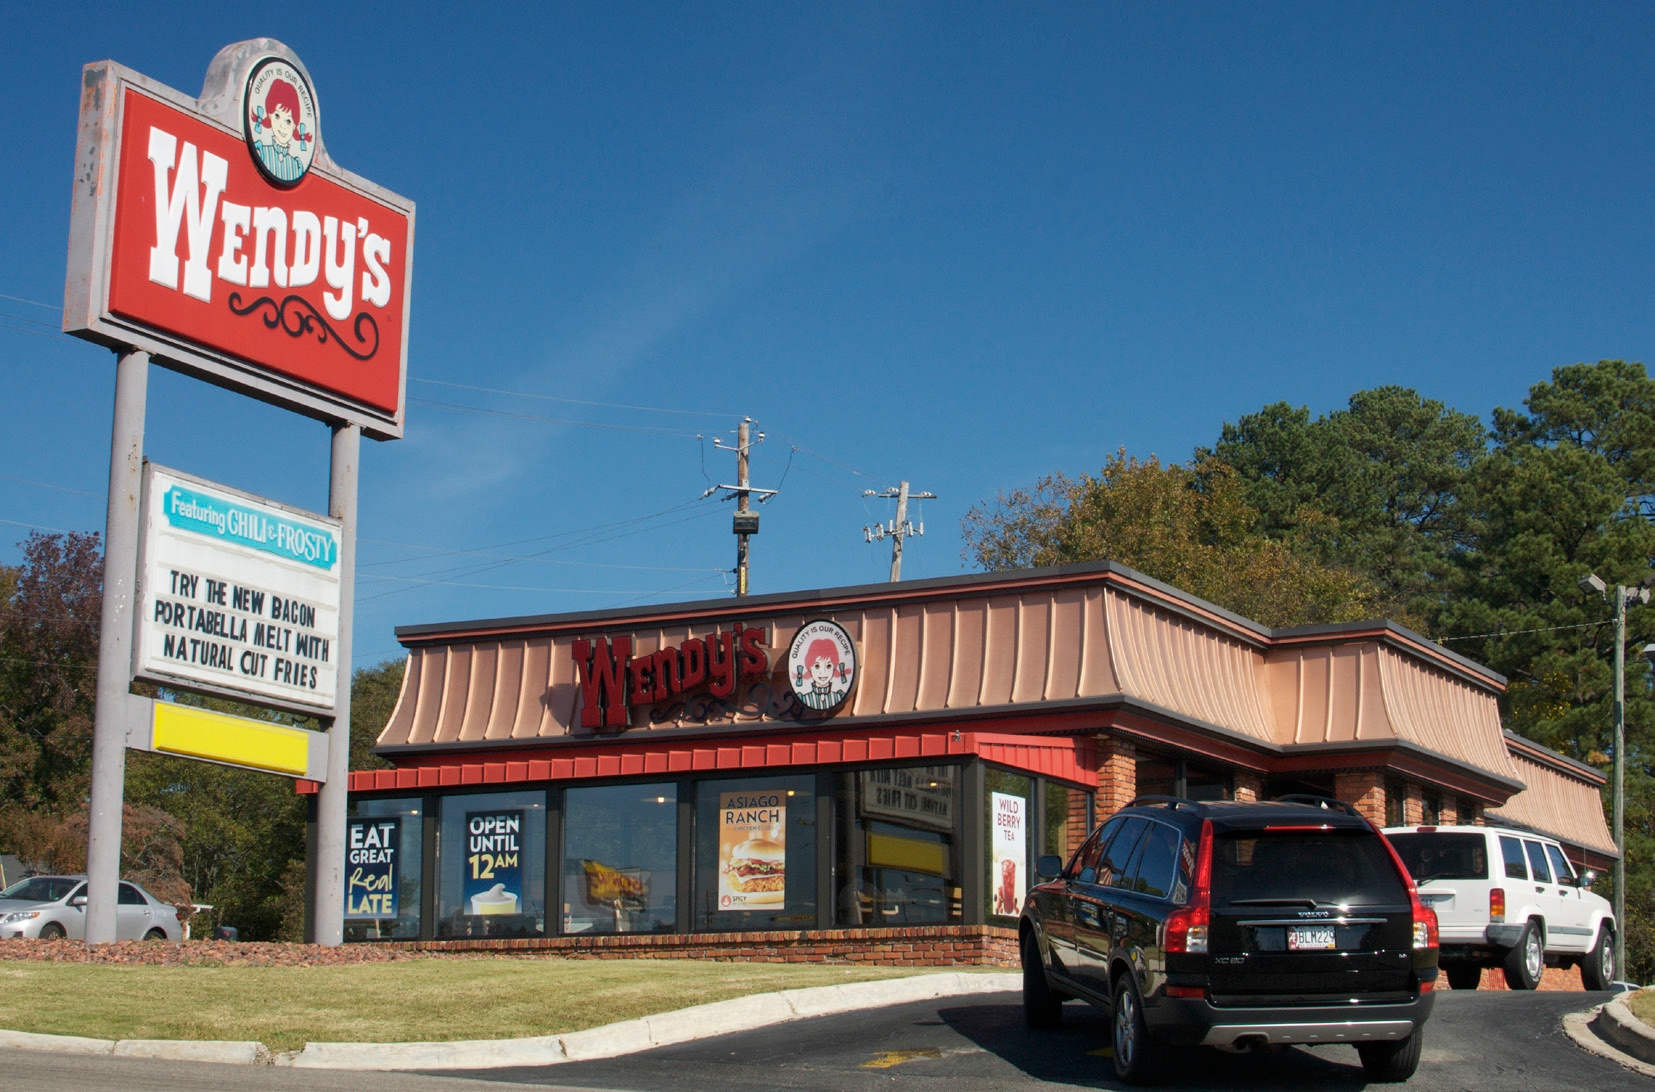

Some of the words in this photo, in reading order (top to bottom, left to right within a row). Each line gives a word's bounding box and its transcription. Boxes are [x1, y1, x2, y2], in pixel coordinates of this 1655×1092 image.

[255, 68, 274, 94] QUALITY
[276, 68, 283, 76] IS
[285, 71, 298, 85] OUR
[298, 85, 312, 118] RECIPE
[171, 491, 225, 534] Featuring
[227, 508, 267, 543] CHILI
[277, 523, 333, 562] FROSTY
[171, 570, 199, 599] TRY
[206, 578, 227, 606] THE
[233, 585, 265, 615] NEW
[271, 595, 316, 628] BACON
[154, 599, 248, 643] PORTABELLA
[253, 622, 292, 652] MELT
[296, 632, 330, 662] WITH
[792, 630, 810, 659] QUALITY
[819, 625, 834, 634] OUR
[834, 631, 851, 655] RECIPE
[163, 634, 234, 671] NATURAL
[240, 650, 268, 677] CUT
[274, 658, 318, 689] FRIES
[726, 795, 780, 809] ASIAGO
[999, 798, 1019, 814] WILD
[469, 815, 520, 835] OPEN
[725, 809, 780, 825] RANCH
[997, 812, 1020, 829] BERRY
[350, 822, 395, 849] EAT
[470, 834, 520, 853] UNTIL
[1003, 829, 1015, 841] TEA
[349, 848, 395, 864] GREAT
[348, 863, 393, 894] Real
[347, 893, 393, 915] LATE
